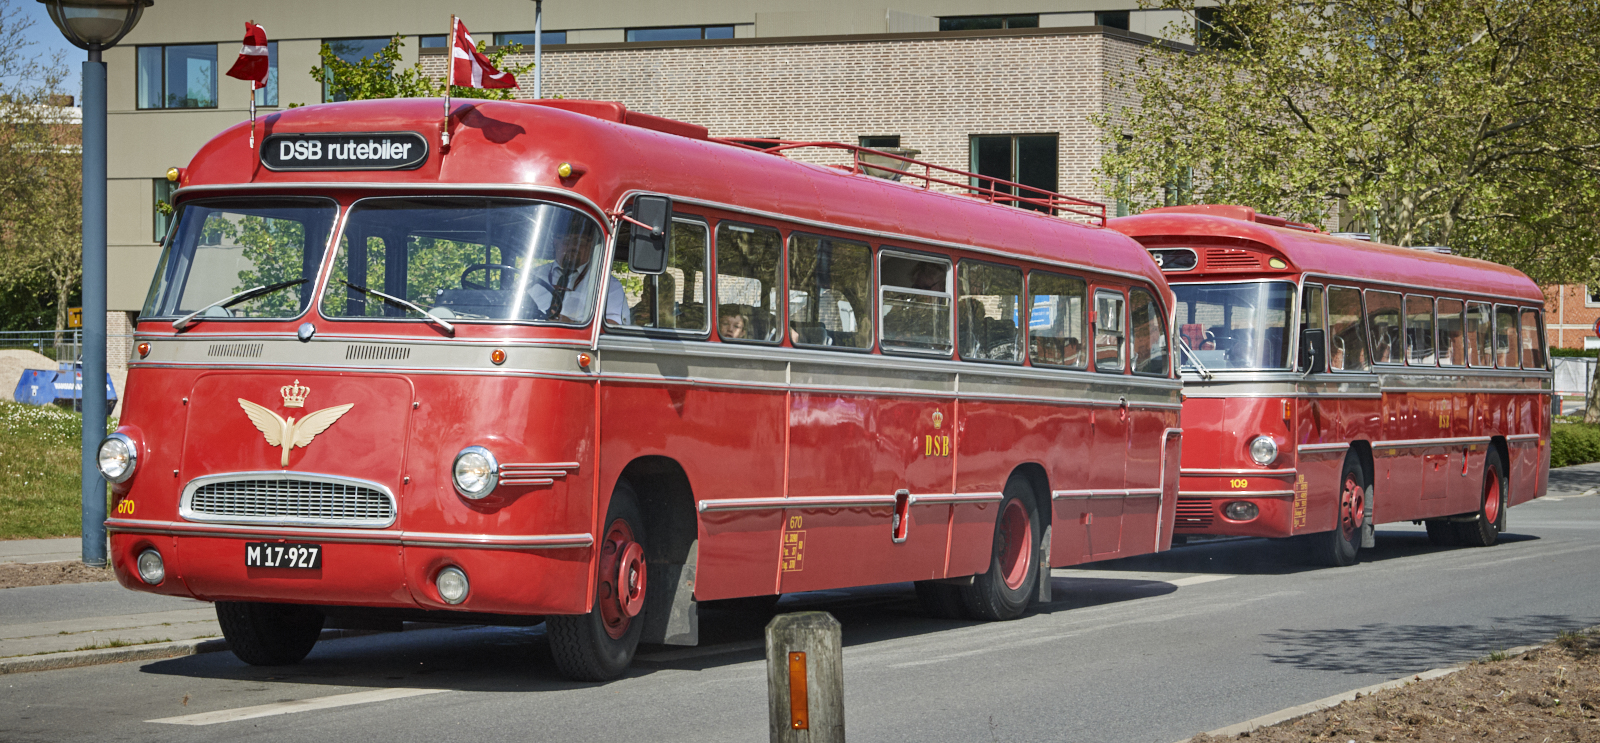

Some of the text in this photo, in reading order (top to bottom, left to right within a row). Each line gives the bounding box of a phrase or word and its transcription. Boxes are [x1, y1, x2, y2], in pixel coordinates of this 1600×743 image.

[279, 139, 412, 161] DSB rutebiler
[925, 434, 950, 457] DSB
[1230, 478, 1248, 489] 109
[117, 499, 135, 515] 670
[790, 515, 803, 529] 670
[247, 545, 261, 566] M
